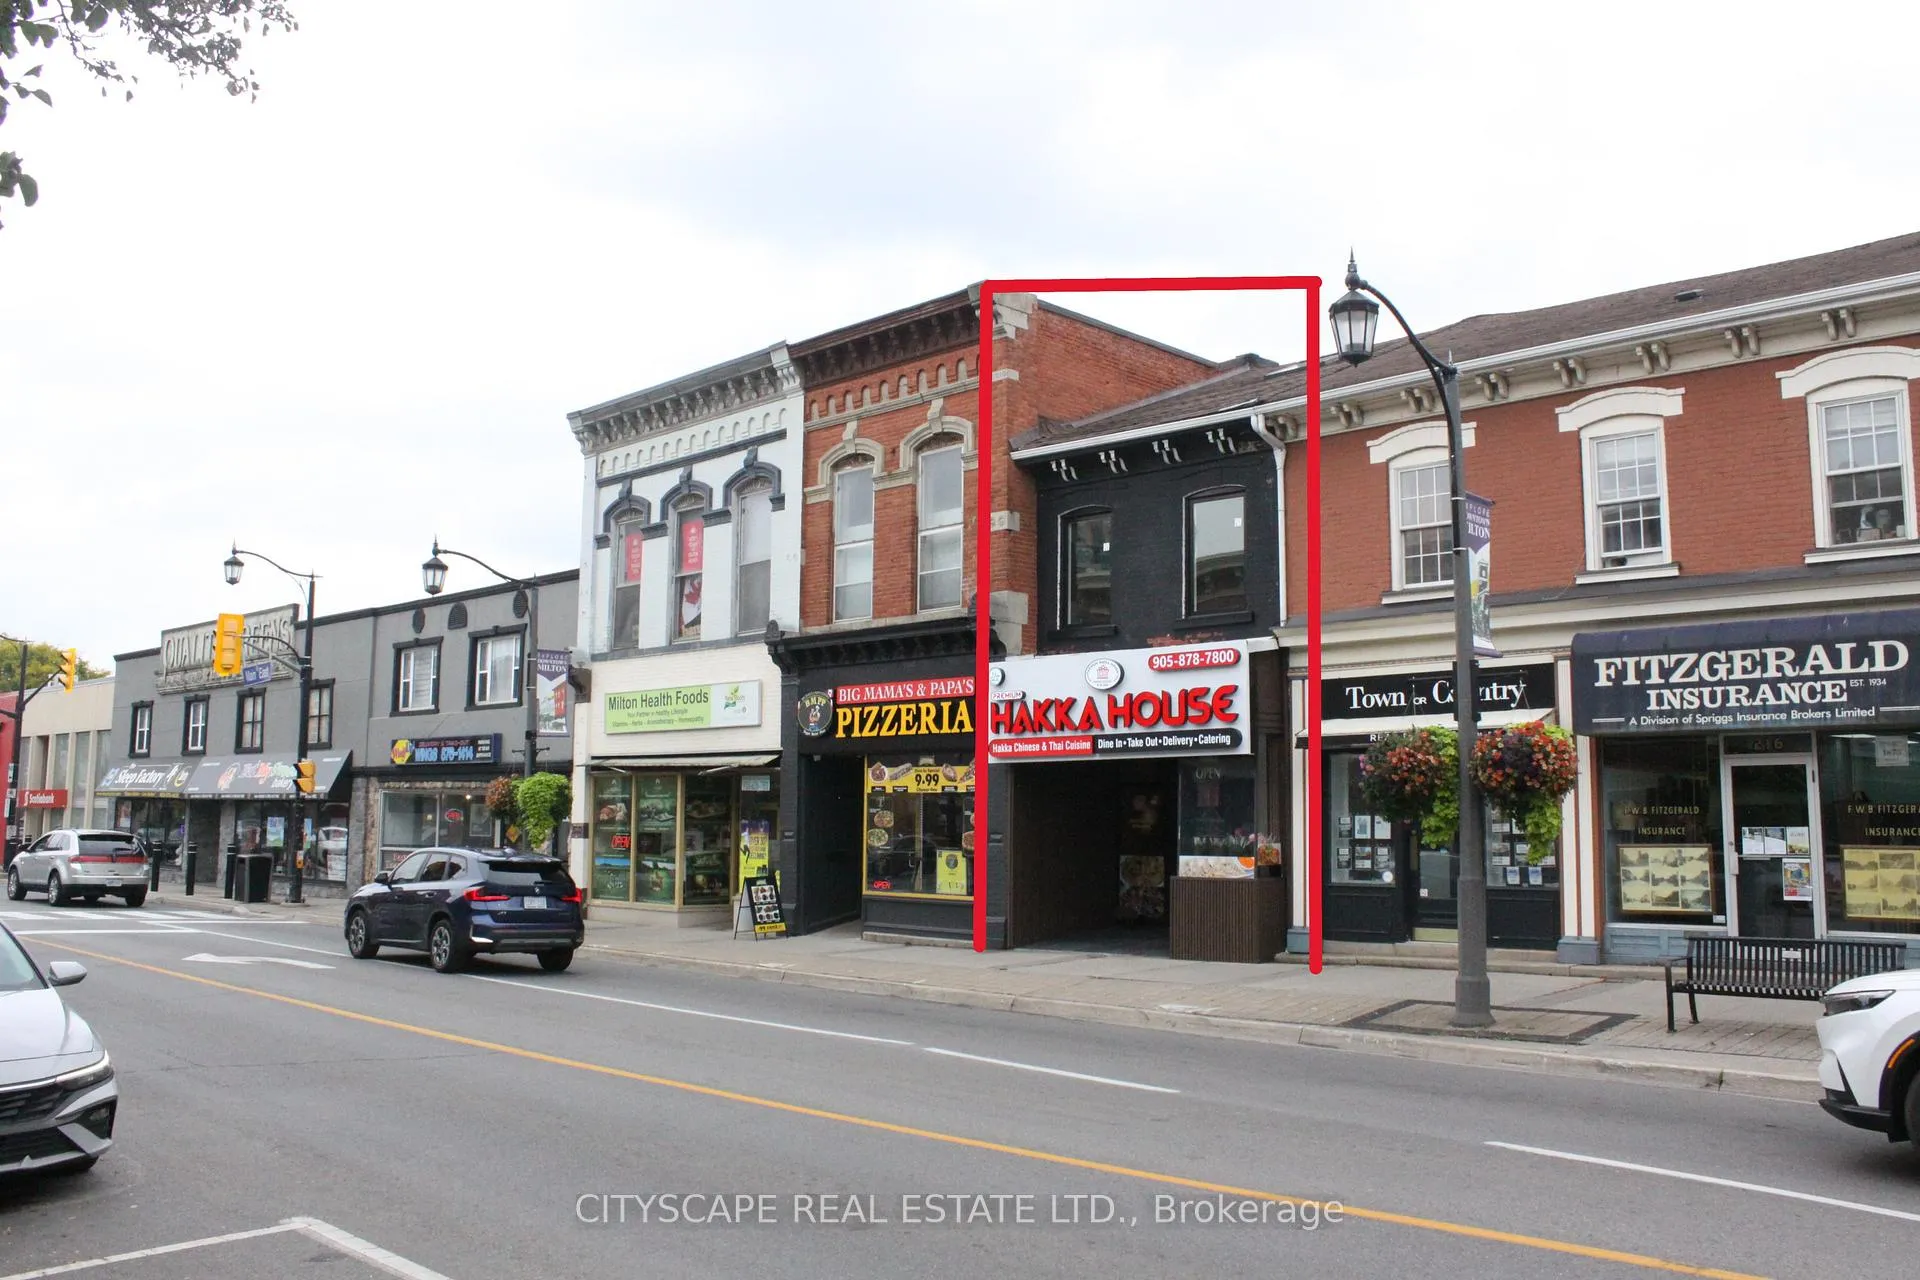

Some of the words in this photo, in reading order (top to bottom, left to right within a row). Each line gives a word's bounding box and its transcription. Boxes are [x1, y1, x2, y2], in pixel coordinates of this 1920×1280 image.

[1466, 521, 1490, 539] ILTON
[163, 632, 217, 668] QUALIT
[1152, 650, 1234, 669] 905-878-7800
[1594, 640, 1909, 687] FITZGERALD
[537, 664, 567, 672] MILTON
[1850, 679, 1865, 687] EST.
[1869, 678, 1887, 687] 1934
[839, 687, 861, 702] BIG
[864, 683, 914, 701] MAMA'S
[917, 682, 926, 697] &
[930, 679, 975, 696] PAPA'S
[992, 692, 1021, 700] PREMIUM
[1346, 686, 1407, 710] Town
[1433, 680, 1526, 708] Cntry
[1646, 680, 1848, 711] INSURANCE
[608, 697, 637, 711] Milton
[641, 693, 673, 708] Health
[676, 690, 709, 704] Foods
[991, 696, 1104, 735] HAKKA
[1107, 684, 1239, 728] HOUSE
[1629, 717, 1637, 726] A
[1640, 715, 1679, 725] Division
[1682, 714, 1693, 724] of
[1695, 713, 1734, 725] Spriggs
[1736, 712, 1787, 722] Insurance
[1791, 709, 1832, 720] Brokers
[1835, 706, 1876, 718] Limited
[836, 699, 974, 739] PIZZERIA
[992, 743, 1012, 753] Hakka
[1014, 742, 1040, 752] Chinese
[1041, 742, 1047, 751] &
[1049, 740, 1064, 751] Thai
[1065, 740, 1091, 751] Cuisine
[1098, 738, 1114, 749] Dine
[1115, 738, 1123, 748] In
[1127, 736, 1144, 748] Take
[1146, 736, 1159, 747] Out
[1163, 735, 1194, 748] Delivery
[1198, 734, 1231, 746] Catering
[114, 767, 136, 789] Sleep
[136, 768, 165, 788] Factory
[914, 773, 940, 787] 9.99
[1195, 767, 1221, 780] OPEN
[29, 793, 54, 804] Scotiabank
[1651, 806, 1700, 815] FITZGERALD
[1878, 804, 1920, 814] FITZGER
[1638, 826, 1686, 836] INSURANCE
[611, 835, 631, 849] OPEN
[873, 881, 891, 889] OPEN
